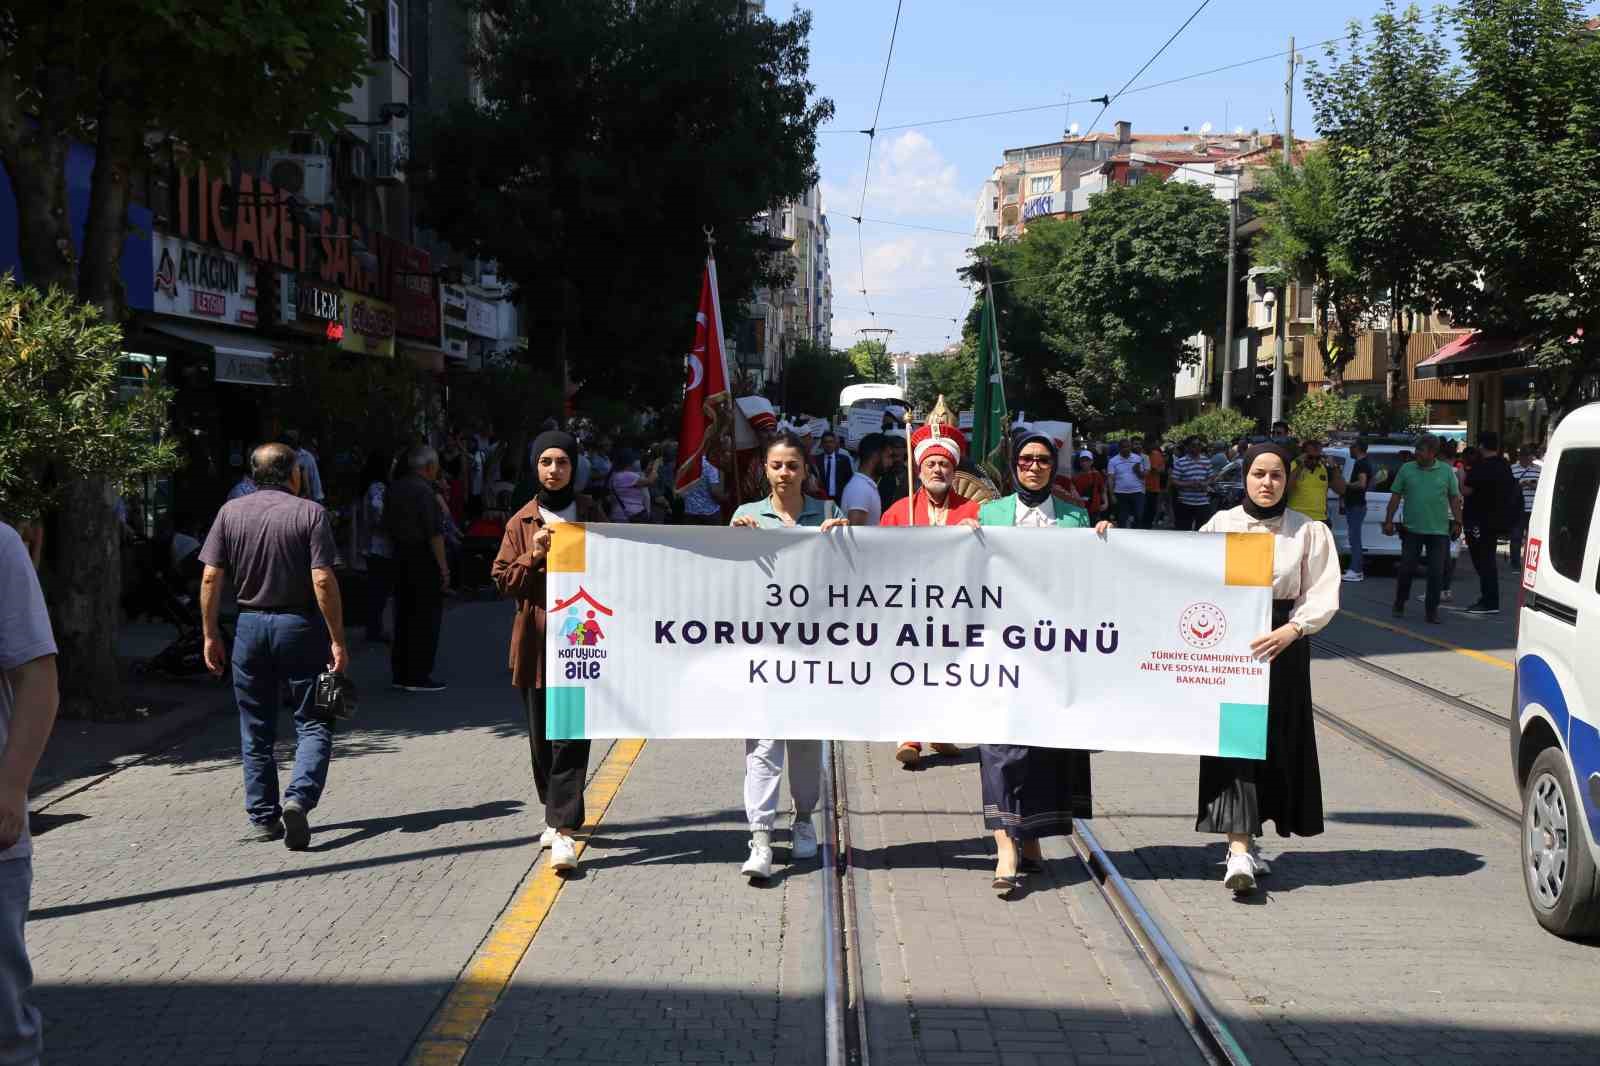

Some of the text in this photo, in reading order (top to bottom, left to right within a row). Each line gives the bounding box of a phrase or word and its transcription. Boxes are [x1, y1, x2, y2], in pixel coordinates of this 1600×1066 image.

[766, 577, 1003, 609] 30 HAZİRAN
[655, 616, 1119, 654] KORUYUCU AİLE GÜNÜ
[1152, 650, 1190, 661] TÜRKİYE
[565, 661, 600, 680] aile
[750, 660, 1020, 689] KUTLU OLSUN
[1161, 663, 1174, 671] VE
[1175, 664, 1209, 673] SOSYAL
[1211, 664, 1263, 676] HİZMETLER
